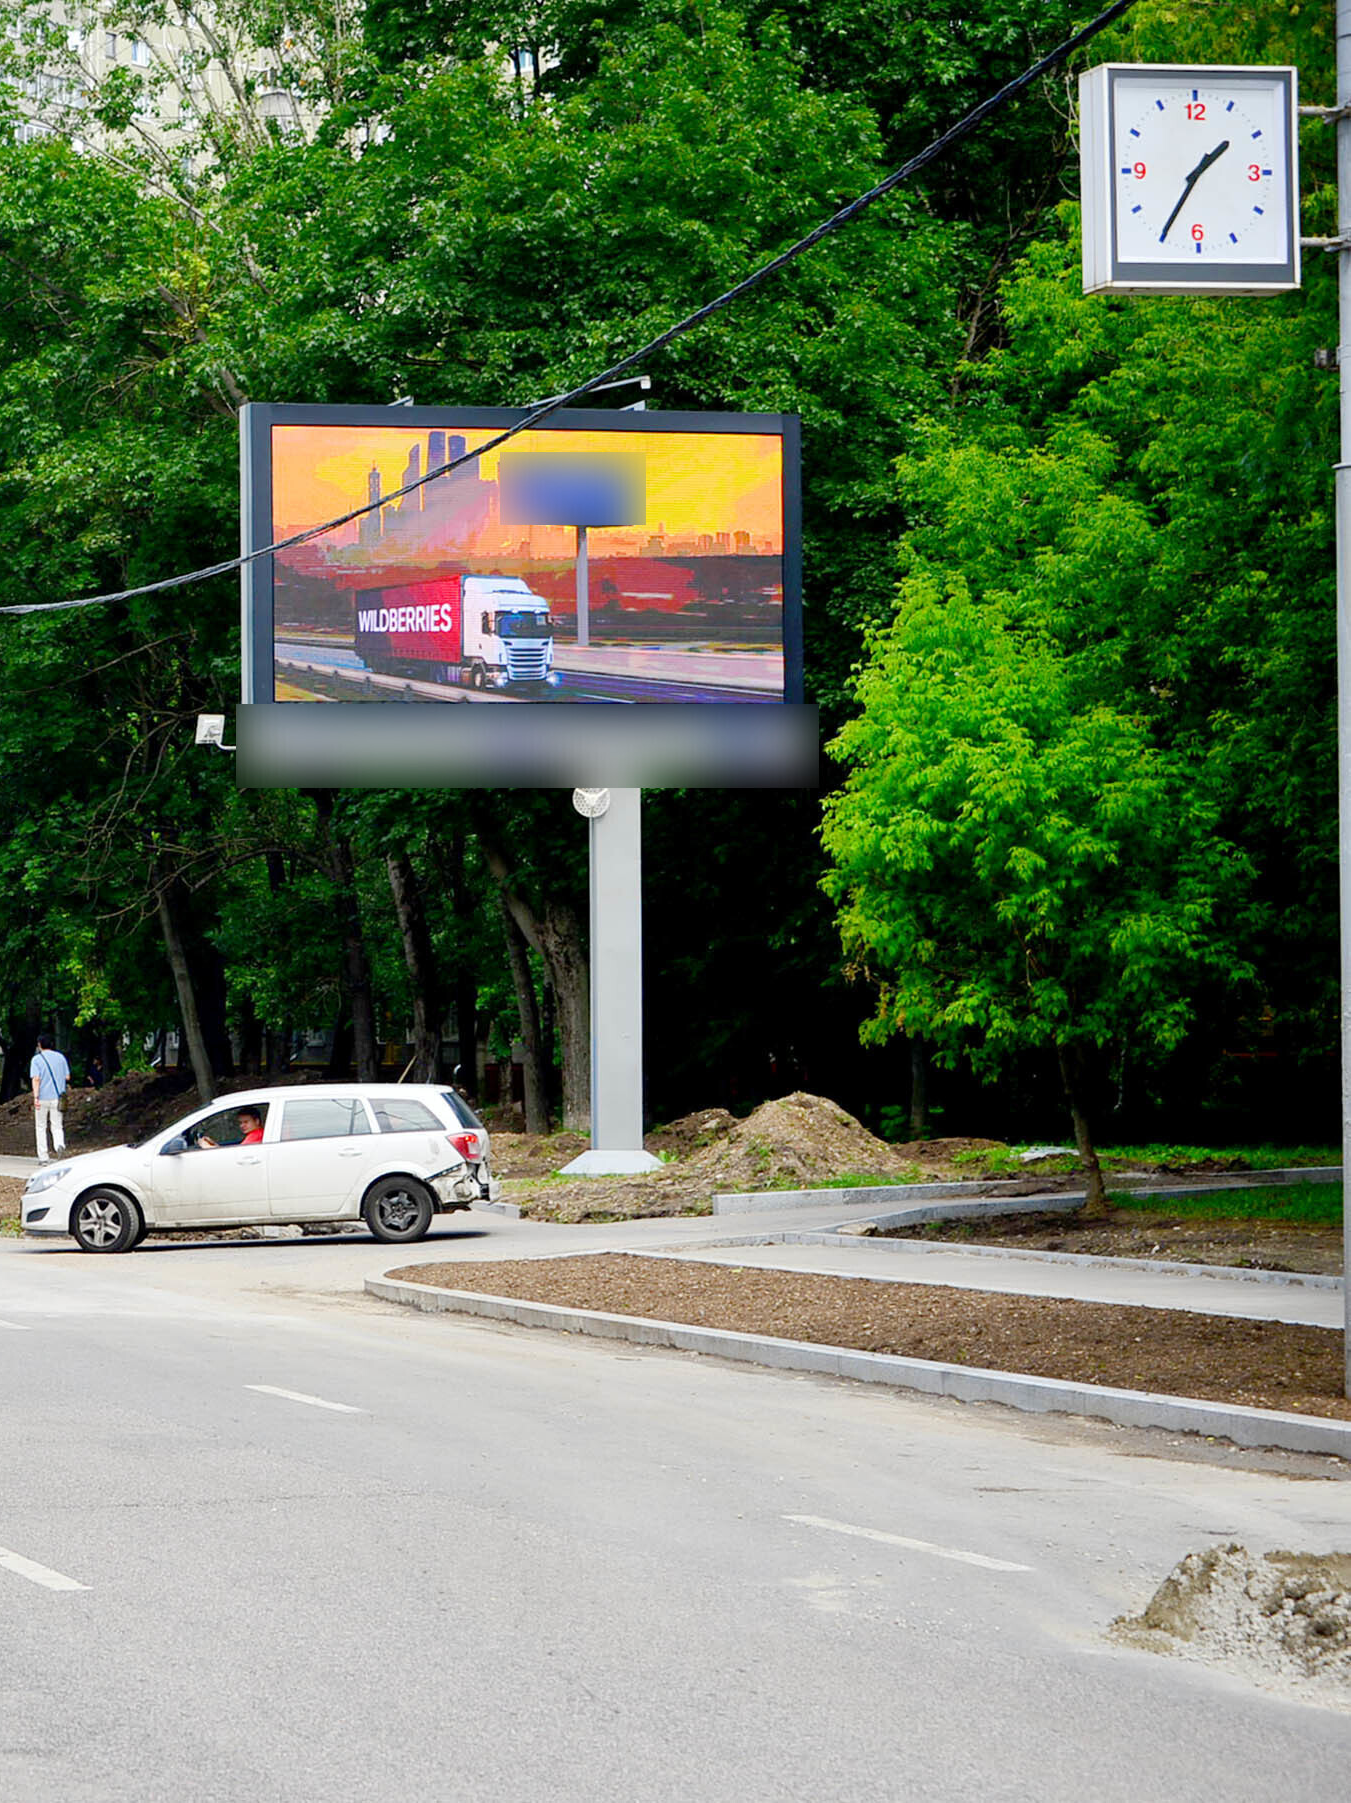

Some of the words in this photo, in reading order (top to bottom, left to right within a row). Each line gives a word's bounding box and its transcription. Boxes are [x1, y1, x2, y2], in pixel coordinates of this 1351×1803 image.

[1184, 103, 1206, 121] 12
[1134, 162, 1147, 180] 9
[1247, 164, 1261, 182] 3
[1191, 223, 1204, 241] 6
[358, 603, 452, 632] WILDBERRIES
